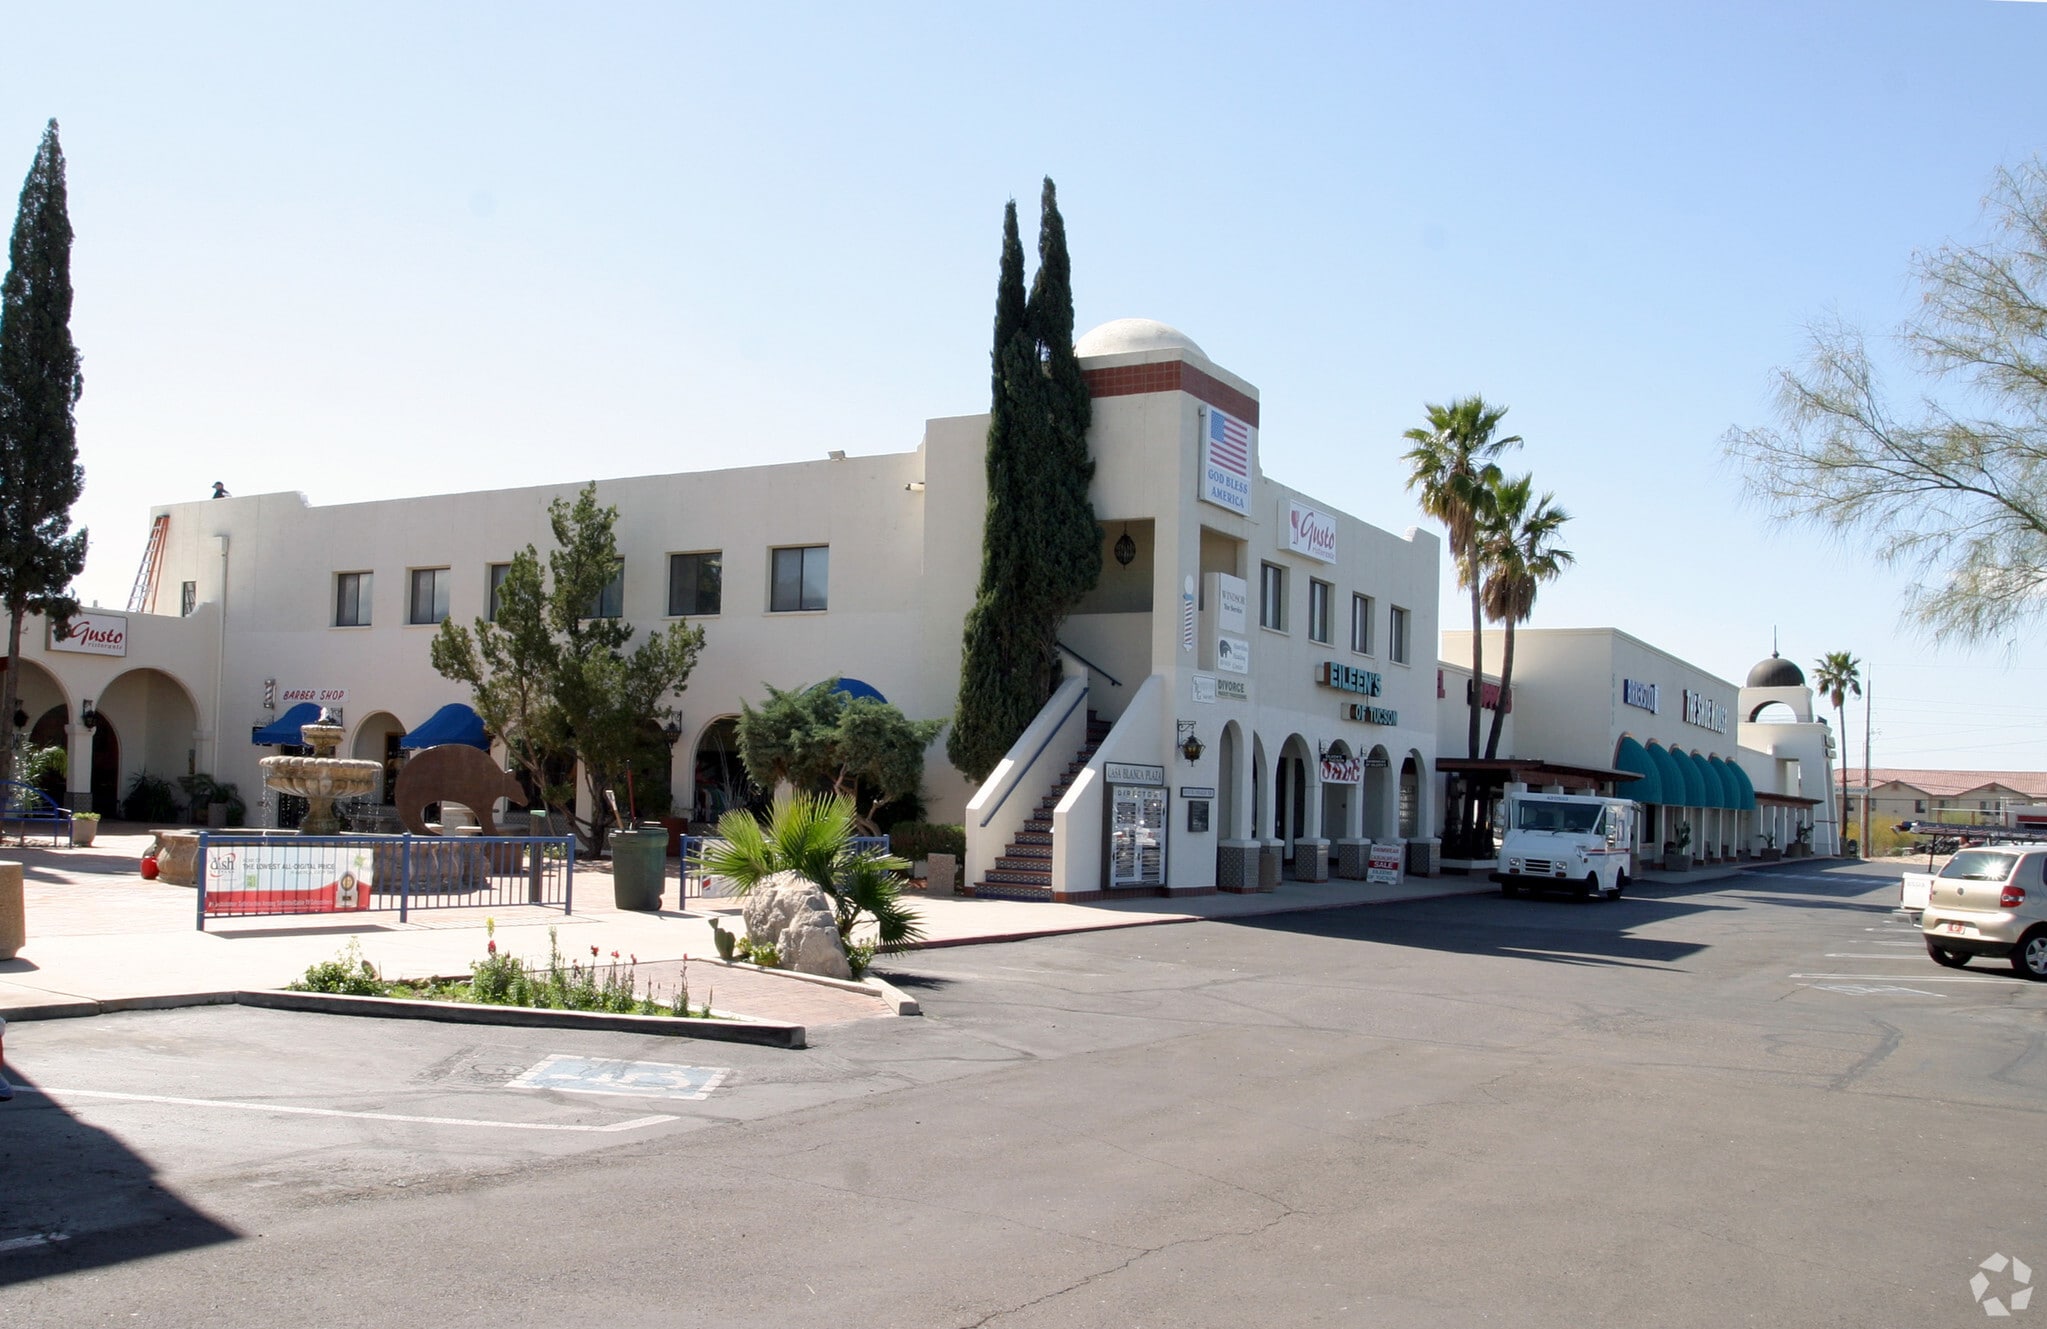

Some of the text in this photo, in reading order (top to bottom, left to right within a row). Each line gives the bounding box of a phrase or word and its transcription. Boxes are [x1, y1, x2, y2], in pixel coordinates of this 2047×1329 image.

[1208, 468, 1248, 495] GOD BLESS
[1211, 486, 1244, 508] AMERICA
[1300, 511, 1335, 551] Gusto
[70, 621, 123, 646] Gusto
[1217, 679, 1245, 693] DIVORCE
[1330, 661, 1382, 697] EILEEN'S
[283, 690, 345, 700] BARBER SHOP
[1355, 704, 1398, 726] OF TUCSON
[1107, 766, 1161, 781] CASA BLANCA PLAZA
[211, 857, 234, 870] dish
